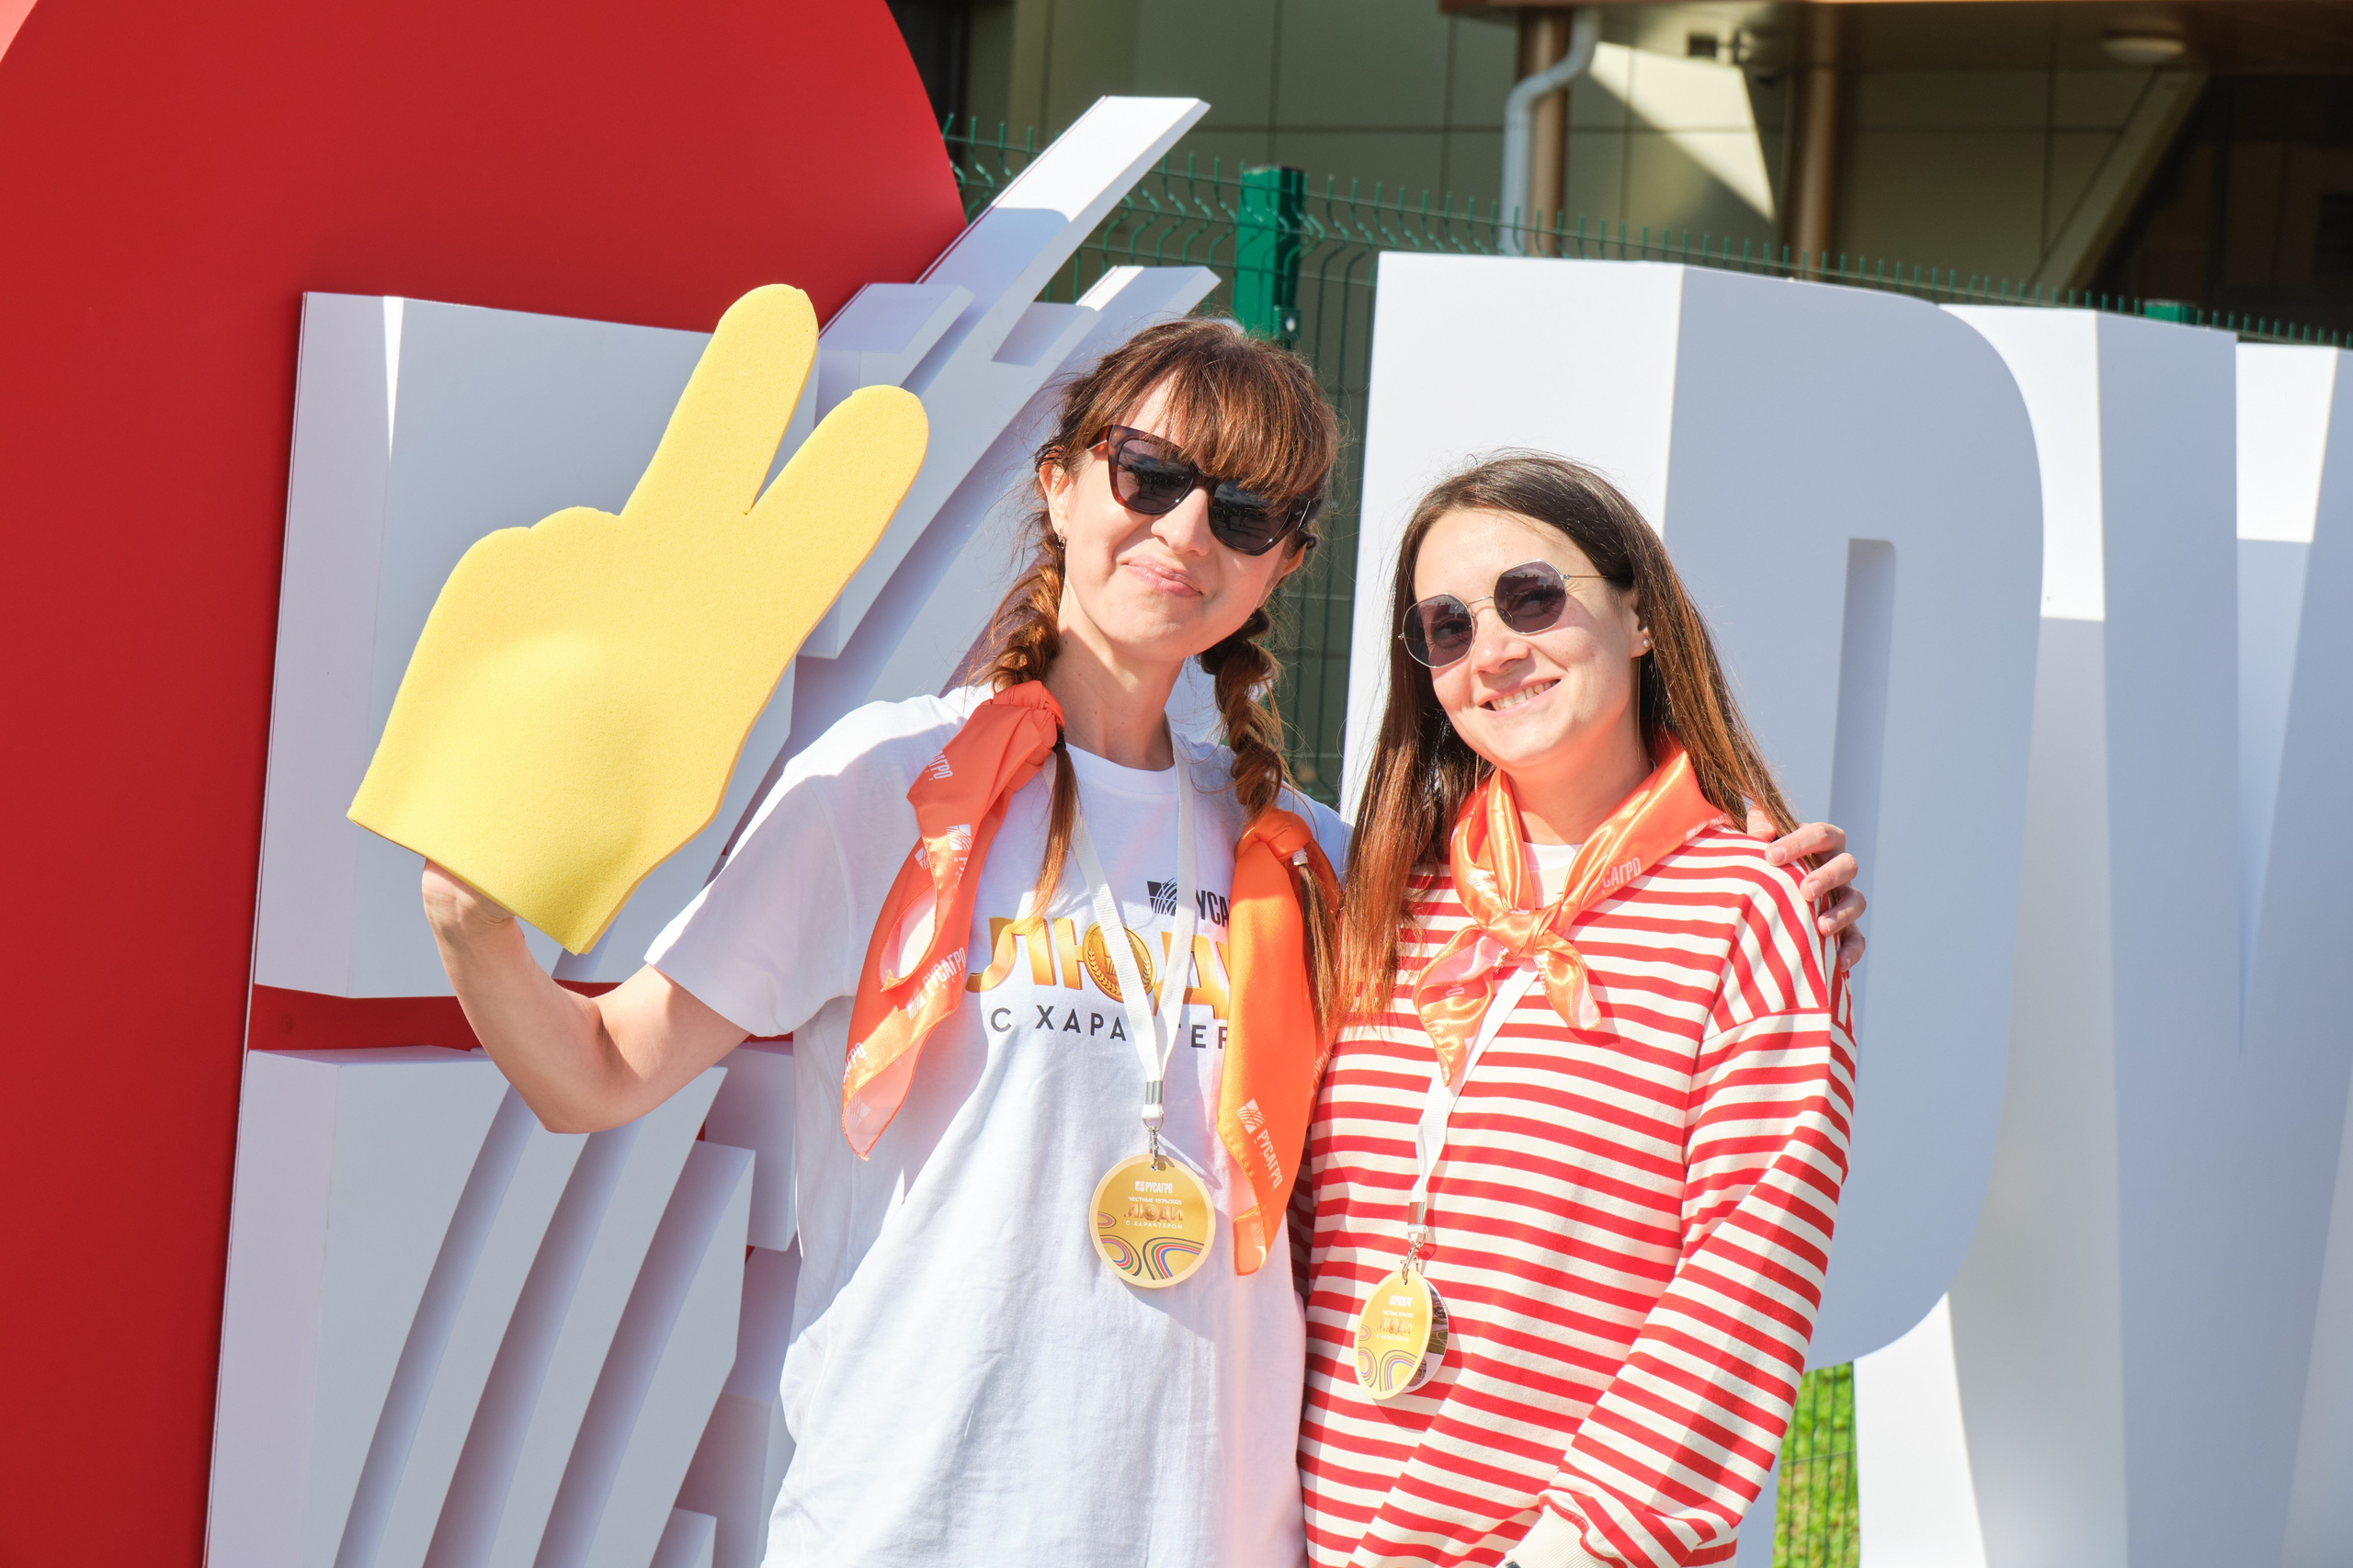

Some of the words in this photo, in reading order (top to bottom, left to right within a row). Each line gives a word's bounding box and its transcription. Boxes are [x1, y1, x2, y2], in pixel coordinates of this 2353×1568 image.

[991, 1007, 1012, 1032] С
[1256, 1129, 1283, 1189] РУСАГРО
[1145, 1181, 1173, 1194] РУСАГРО
[1123, 1203, 1183, 1222] ЛЮДИ
[1133, 1221, 1183, 1229] ХАРАКТЕРОМ
